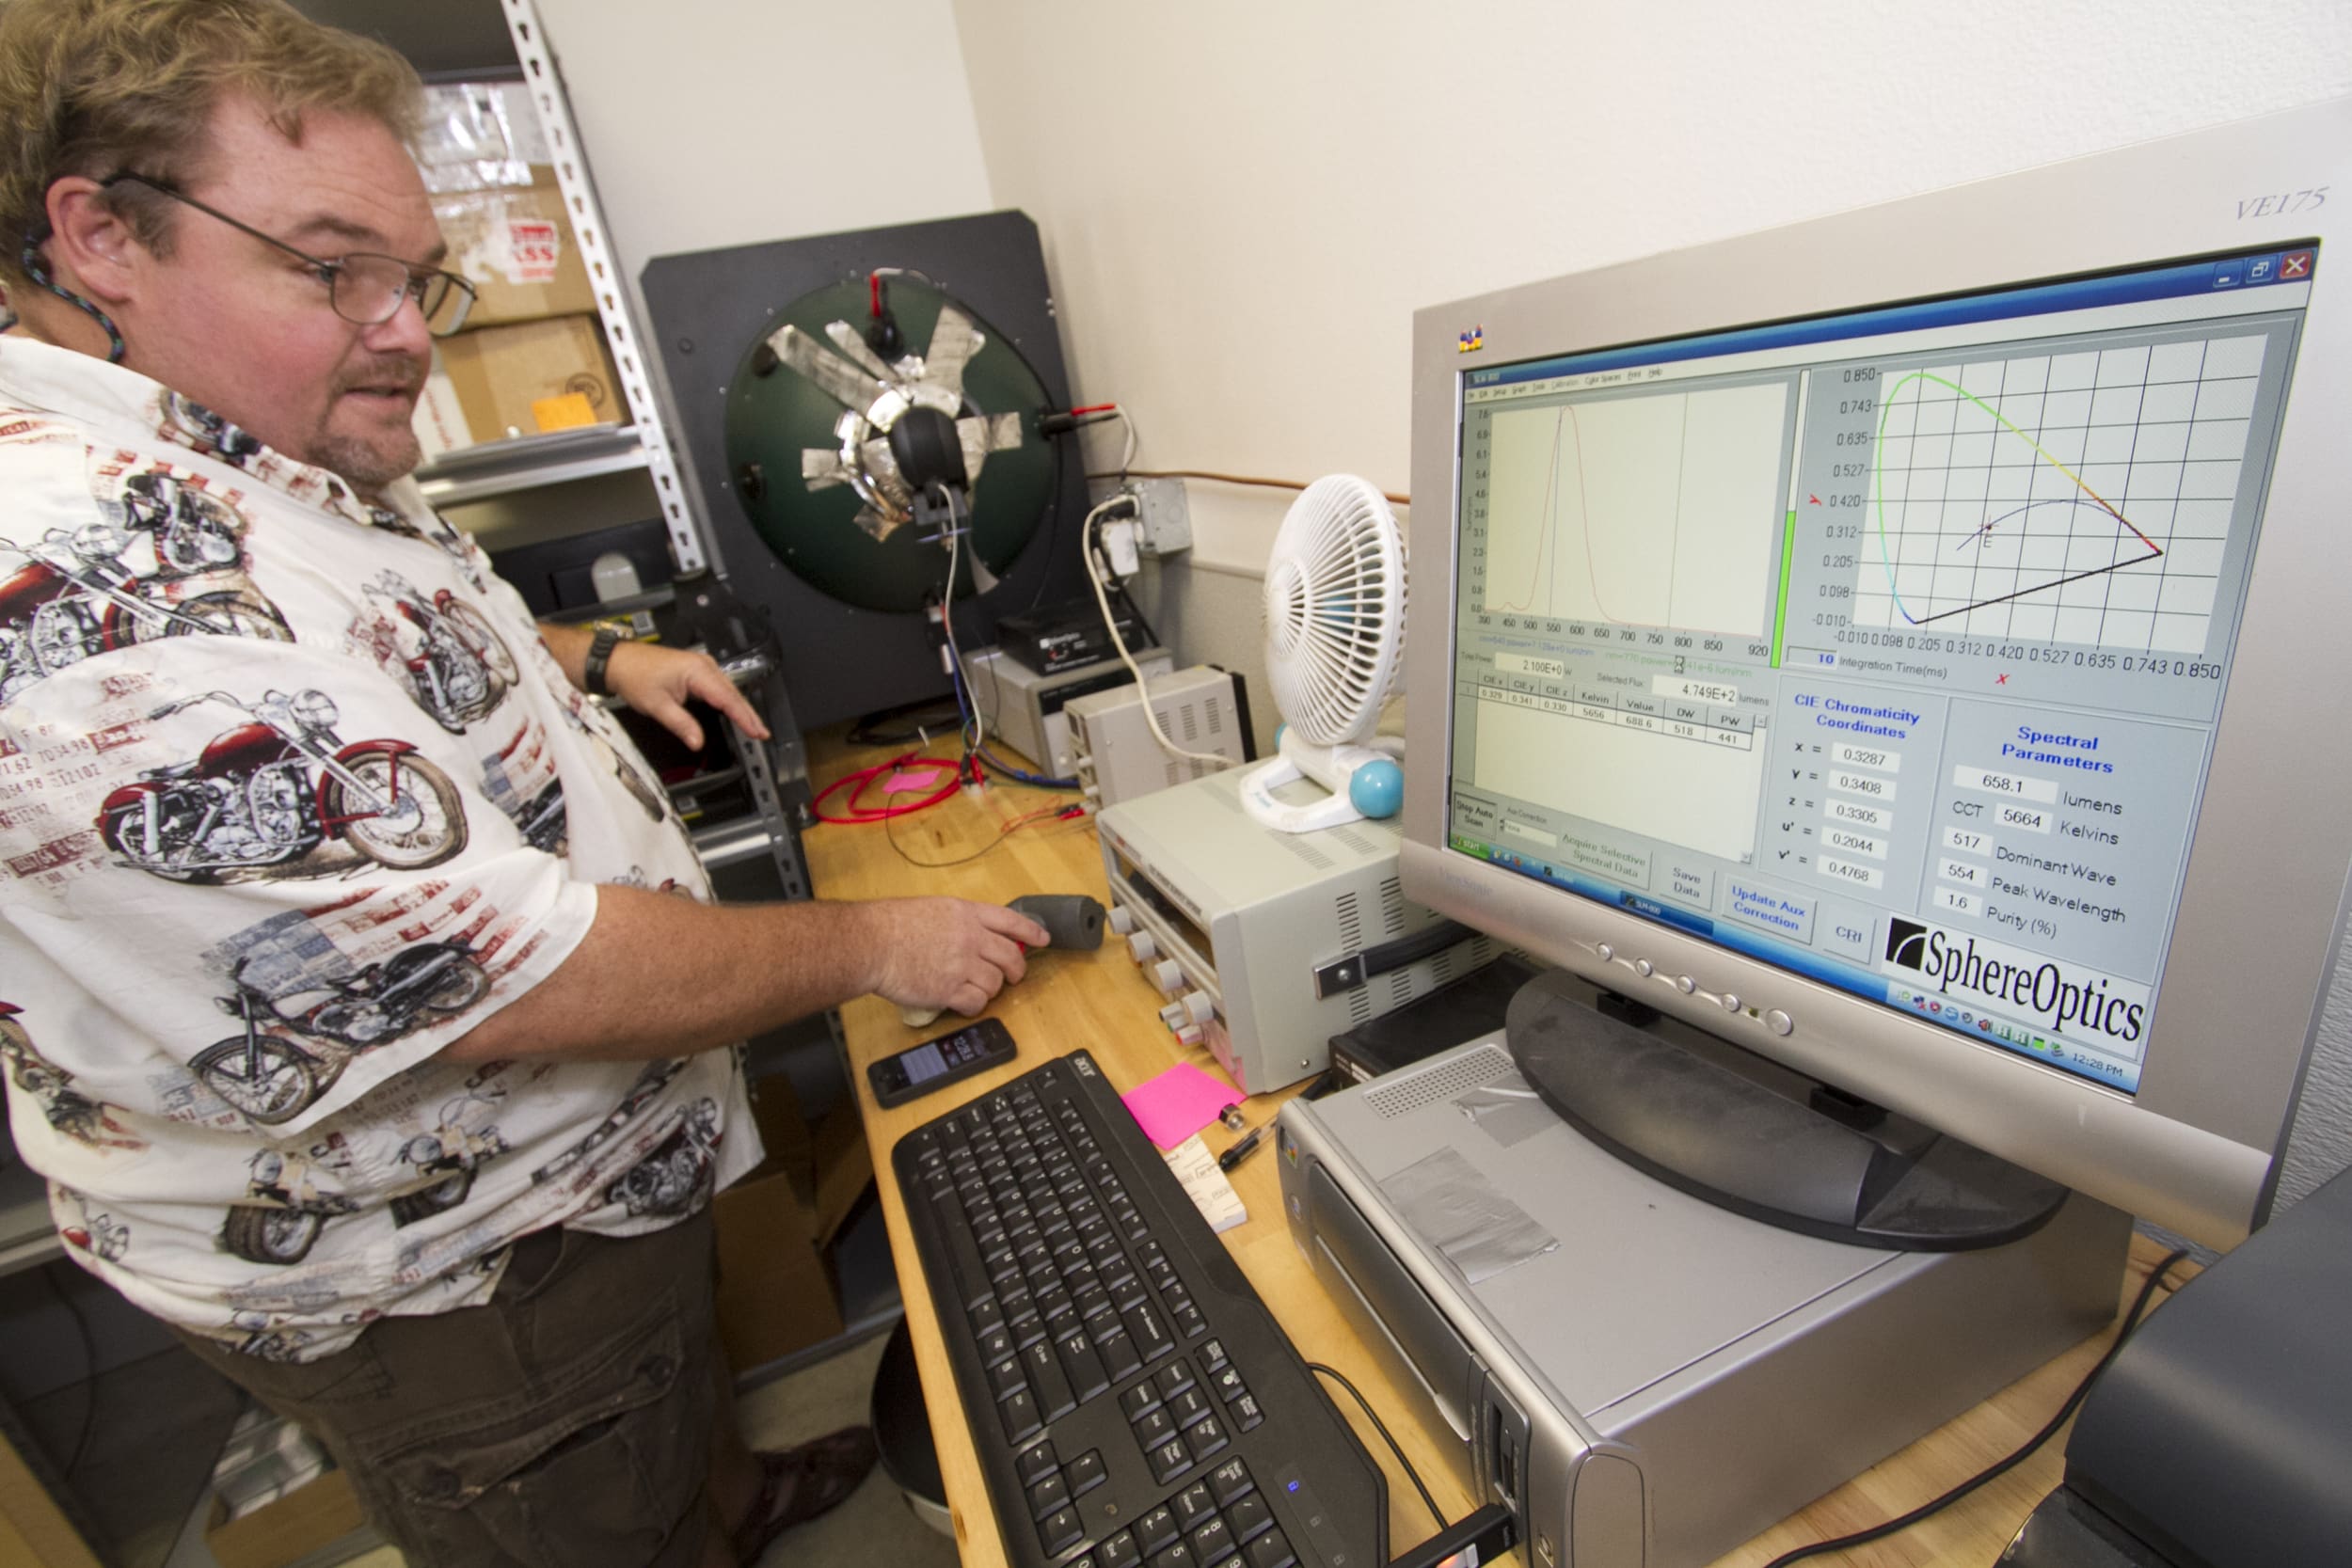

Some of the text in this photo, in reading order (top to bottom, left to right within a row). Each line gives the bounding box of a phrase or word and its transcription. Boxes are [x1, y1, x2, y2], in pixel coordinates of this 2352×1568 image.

[2237, 186, 2330, 220] VE175
[1844, 368, 1876, 383] 0.850
[1840, 400, 1872, 414] 0.743
[1836, 432, 1868, 446] 0.635
[1833, 464, 1865, 478] 0.527
[1830, 495, 1862, 508] 0.420
[1826, 525, 1857, 539] 0.312
[1983, 535, 1992, 547] E
[1822, 555, 1854, 568] 0.205
[1820, 585, 1850, 599] 0.098
[1812, 613, 1848, 628] -0.010
[1502, 617, 1516, 627] 450
[1523, 620, 1537, 630] 500
[1547, 623, 1561, 633] 550
[1569, 625, 1584, 636] 600
[1594, 627, 1610, 639] 650
[1620, 630, 1636, 641] 700
[1646, 633, 1663, 645] 750
[1675, 636, 1692, 648] 800
[1704, 639, 1724, 652] 850
[1748, 644, 1769, 657] 920
[1834, 630, 2221, 680] -0.010 0.098 0.205 0.312 0.420 0.527 0.635 0.743 0.850
[1818, 653, 1947, 679] 10 Integration Time(ms)
[1483, 674, 1498, 685] CIE
[1513, 680, 1528, 690] CIE
[1546, 683, 1561, 695] CIE
[1581, 691, 1610, 705] Kelvin
[1597, 673, 1629, 686] Selected
[1682, 684, 1736, 703] 4.749E+2
[1739, 691, 1770, 706] lumens
[1582, 707, 1605, 720] 5656
[1626, 699, 1654, 712] Value
[1677, 706, 1695, 720] DW
[1794, 692, 1921, 726] CIE Chromaticity
[1674, 723, 1694, 736] 518
[1721, 714, 1740, 727] PW
[1816, 714, 1906, 740] Coordinates
[1718, 733, 1738, 745] 441
[2017, 725, 2099, 751] Spectral
[1843, 748, 1886, 767] 0.3287
[2001, 741, 2114, 774] Parameters
[1839, 775, 1883, 796] 0.3408
[1981, 773, 2123, 816] 658.1 lumens
[1456, 800, 1494, 819] Stop Auto
[1836, 803, 1878, 824] 0.3305
[1464, 815, 1485, 828] Scan
[1952, 800, 2120, 846] CCT 5664 Kelvins
[1463, 838, 1480, 851] start
[1562, 832, 1646, 866] Acquire Selective
[1832, 832, 1874, 853] 0.2044
[1573, 848, 1639, 879] Spectral Data
[1953, 832, 2117, 887] 517 Dominant Wave
[1673, 866, 1701, 884] Save
[1828, 861, 1869, 882] 0.4768
[1673, 881, 1701, 898] Data
[1947, 864, 2126, 924] 554 Peak Wavelength
[1732, 883, 1806, 917] Update Aux
[1733, 900, 1800, 931] Correction
[1948, 893, 2058, 939] 1.6 Purity (%)
[1835, 925, 1863, 943] CRI
[1925, 930, 2144, 1042] SphereOptics
[2072, 1051, 2124, 1078] 12:28 PM
[1192, 1485, 1204, 1496] 7
[1155, 1512, 1167, 1521] 4
[1209, 1521, 1222, 1533] 8
[1172, 1546, 1184, 1558] 5
